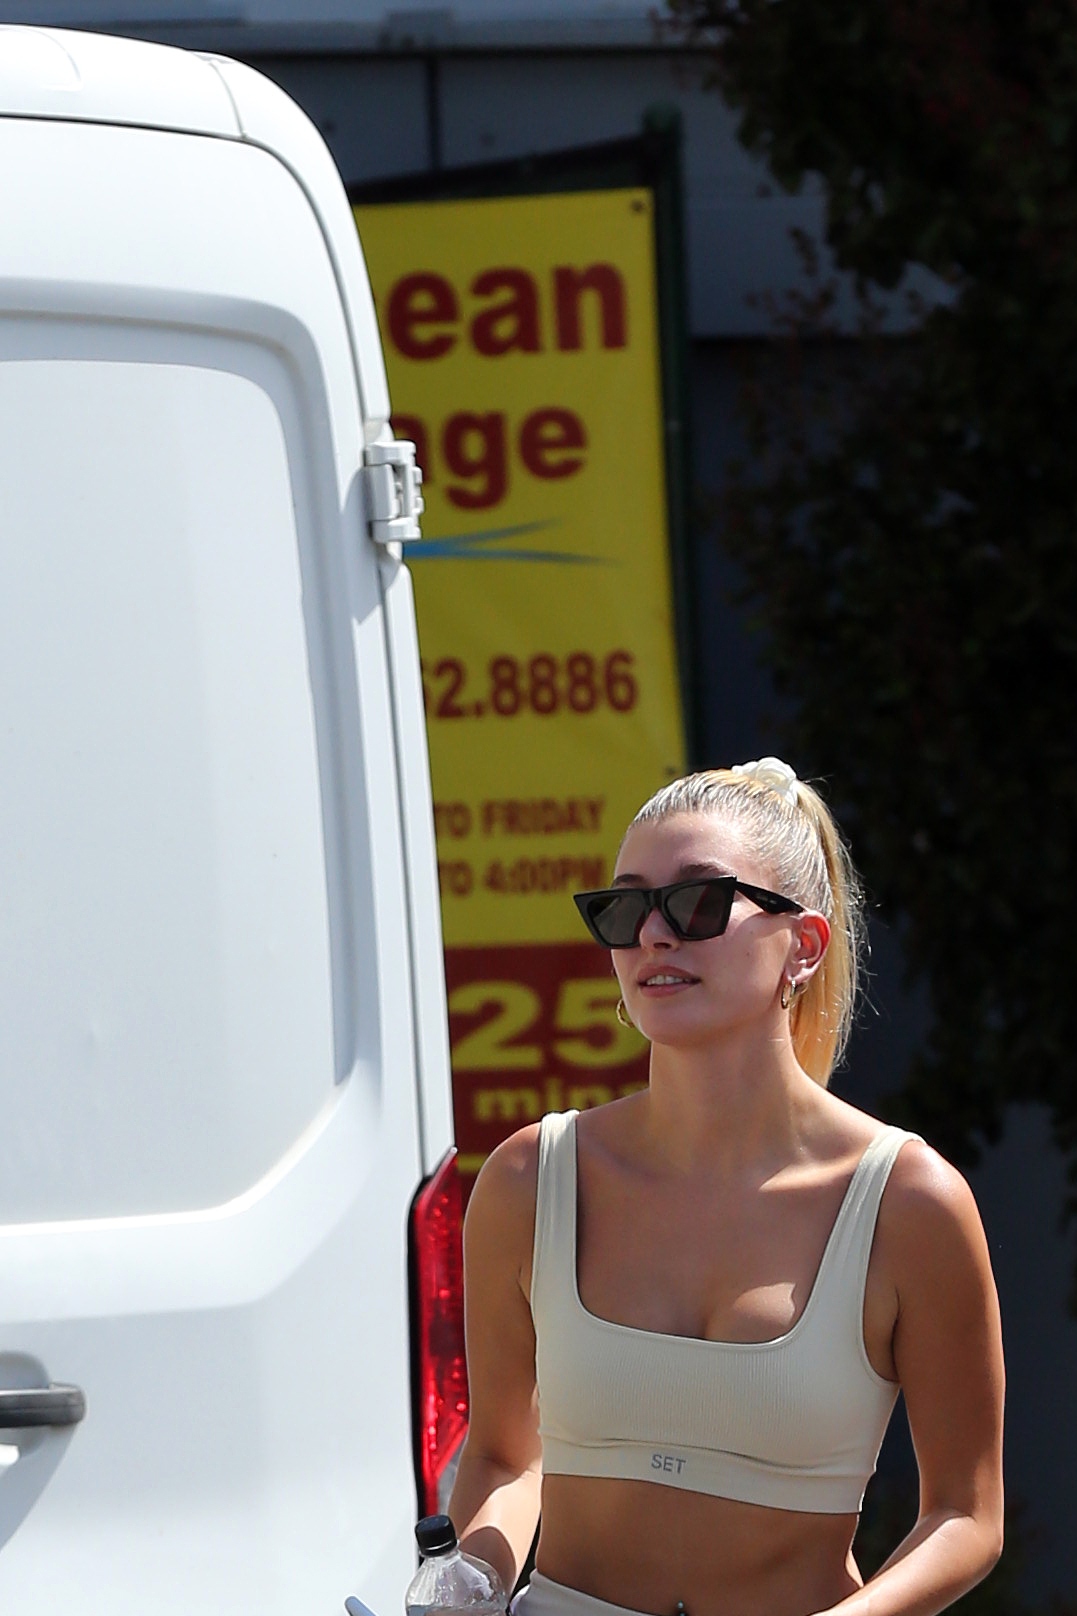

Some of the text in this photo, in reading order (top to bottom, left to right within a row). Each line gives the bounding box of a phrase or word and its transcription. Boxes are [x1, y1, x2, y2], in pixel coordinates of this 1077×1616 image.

[387, 261, 627, 360] ean
[421, 649, 640, 720] 2.8886
[434, 797, 606, 841] TO FRIDAY
[438, 861, 474, 898] TO
[449, 979, 651, 1070] 25
[474, 1079, 650, 1121] min
[651, 1453, 686, 1474] SET
